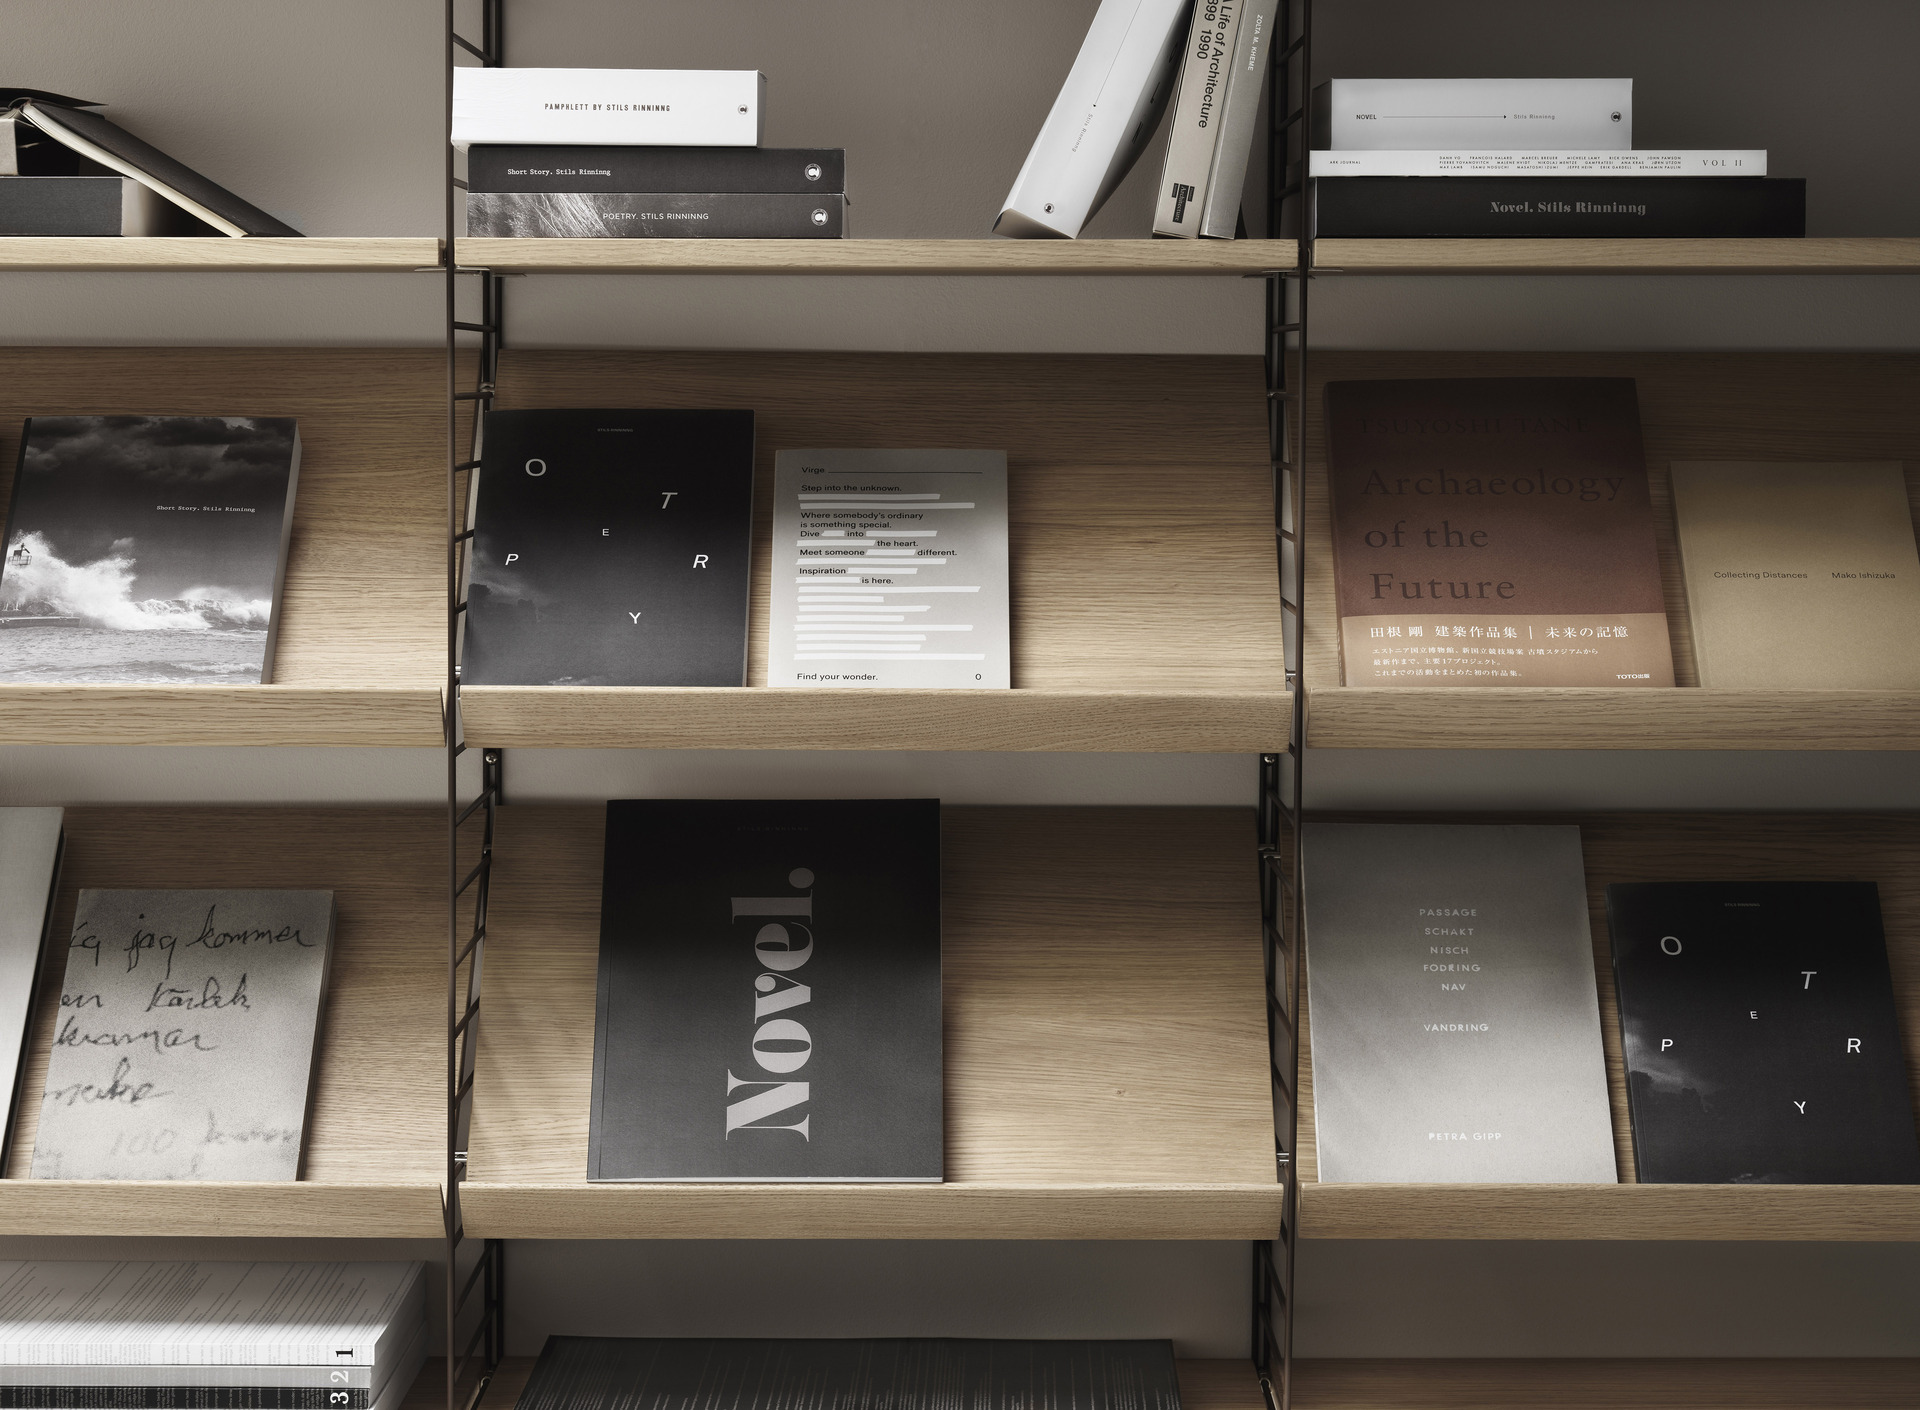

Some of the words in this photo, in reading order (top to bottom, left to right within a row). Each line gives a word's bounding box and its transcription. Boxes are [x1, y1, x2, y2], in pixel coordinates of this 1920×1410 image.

[1218, 6, 1232, 30] Life
[1254, 14, 1263, 35] ZOLTA
[1197, 29, 1212, 60] 1990
[1214, 32, 1226, 47] of
[1252, 37, 1259, 45] M.
[1247, 46, 1259, 71] KHEME
[1198, 47, 1224, 129] Architecture
[607, 104, 628, 112] STILS
[1702, 159, 1726, 167] VOL
[1735, 159, 1742, 167] II
[530, 169, 552, 177] Story.
[579, 169, 611, 177] Rinninng
[1491, 202, 1533, 212] Novel.
[1538, 202, 1571, 212] Stils
[1576, 202, 1645, 215] Rinninng
[603, 213, 638, 221] POETRY.
[1356, 419, 1502, 434] TSUYOSHI
[1514, 419, 1590, 434] TANE
[526, 459, 546, 476] O
[802, 467, 824, 475] Virge
[802, 485, 822, 493] Step
[1360, 468, 1625, 502] Archaeology
[662, 492, 678, 509] T
[888, 513, 923, 521] ordinary
[809, 522, 856, 531] something
[859, 522, 891, 530] special.
[603, 529, 609, 537] E
[1364, 519, 1406, 549] of
[1424, 519, 1490, 549] the
[506, 554, 518, 565] P
[693, 555, 708, 568] R
[800, 568, 846, 576] Inspiration
[1714, 572, 1760, 580] Collecting
[862, 577, 869, 585] is
[1369, 573, 1516, 600] Future
[629, 612, 641, 624] Y
[1371, 626, 1401, 637] 田根
[1409, 626, 1422, 636] 剛
[1435, 626, 1517, 638] 建築作品集
[1546, 626, 1628, 638] 未来の記憶
[1420, 909, 1476, 917] PASSAGE
[185, 903, 317, 948] kommer
[1425, 928, 1473, 936] SCHAKT
[1431, 946, 1468, 955] NISCH
[1661, 936, 1682, 955] O
[1424, 964, 1480, 972] FODRING
[1801, 972, 1817, 989] T
[725, 867, 815, 1142] Novel.
[1750, 1011, 1757, 1020] E
[1424, 1024, 1488, 1032] VANDRING
[1662, 1039, 1673, 1051] P
[1848, 1038, 1861, 1053] R
[1794, 1101, 1805, 1114] Y
[1429, 1133, 1467, 1141] PETRA
[1473, 1133, 1501, 1141] GIPP
[335, 1348, 354, 1359] 1
[330, 1371, 349, 1383] 2
[330, 1391, 349, 1405] 3
